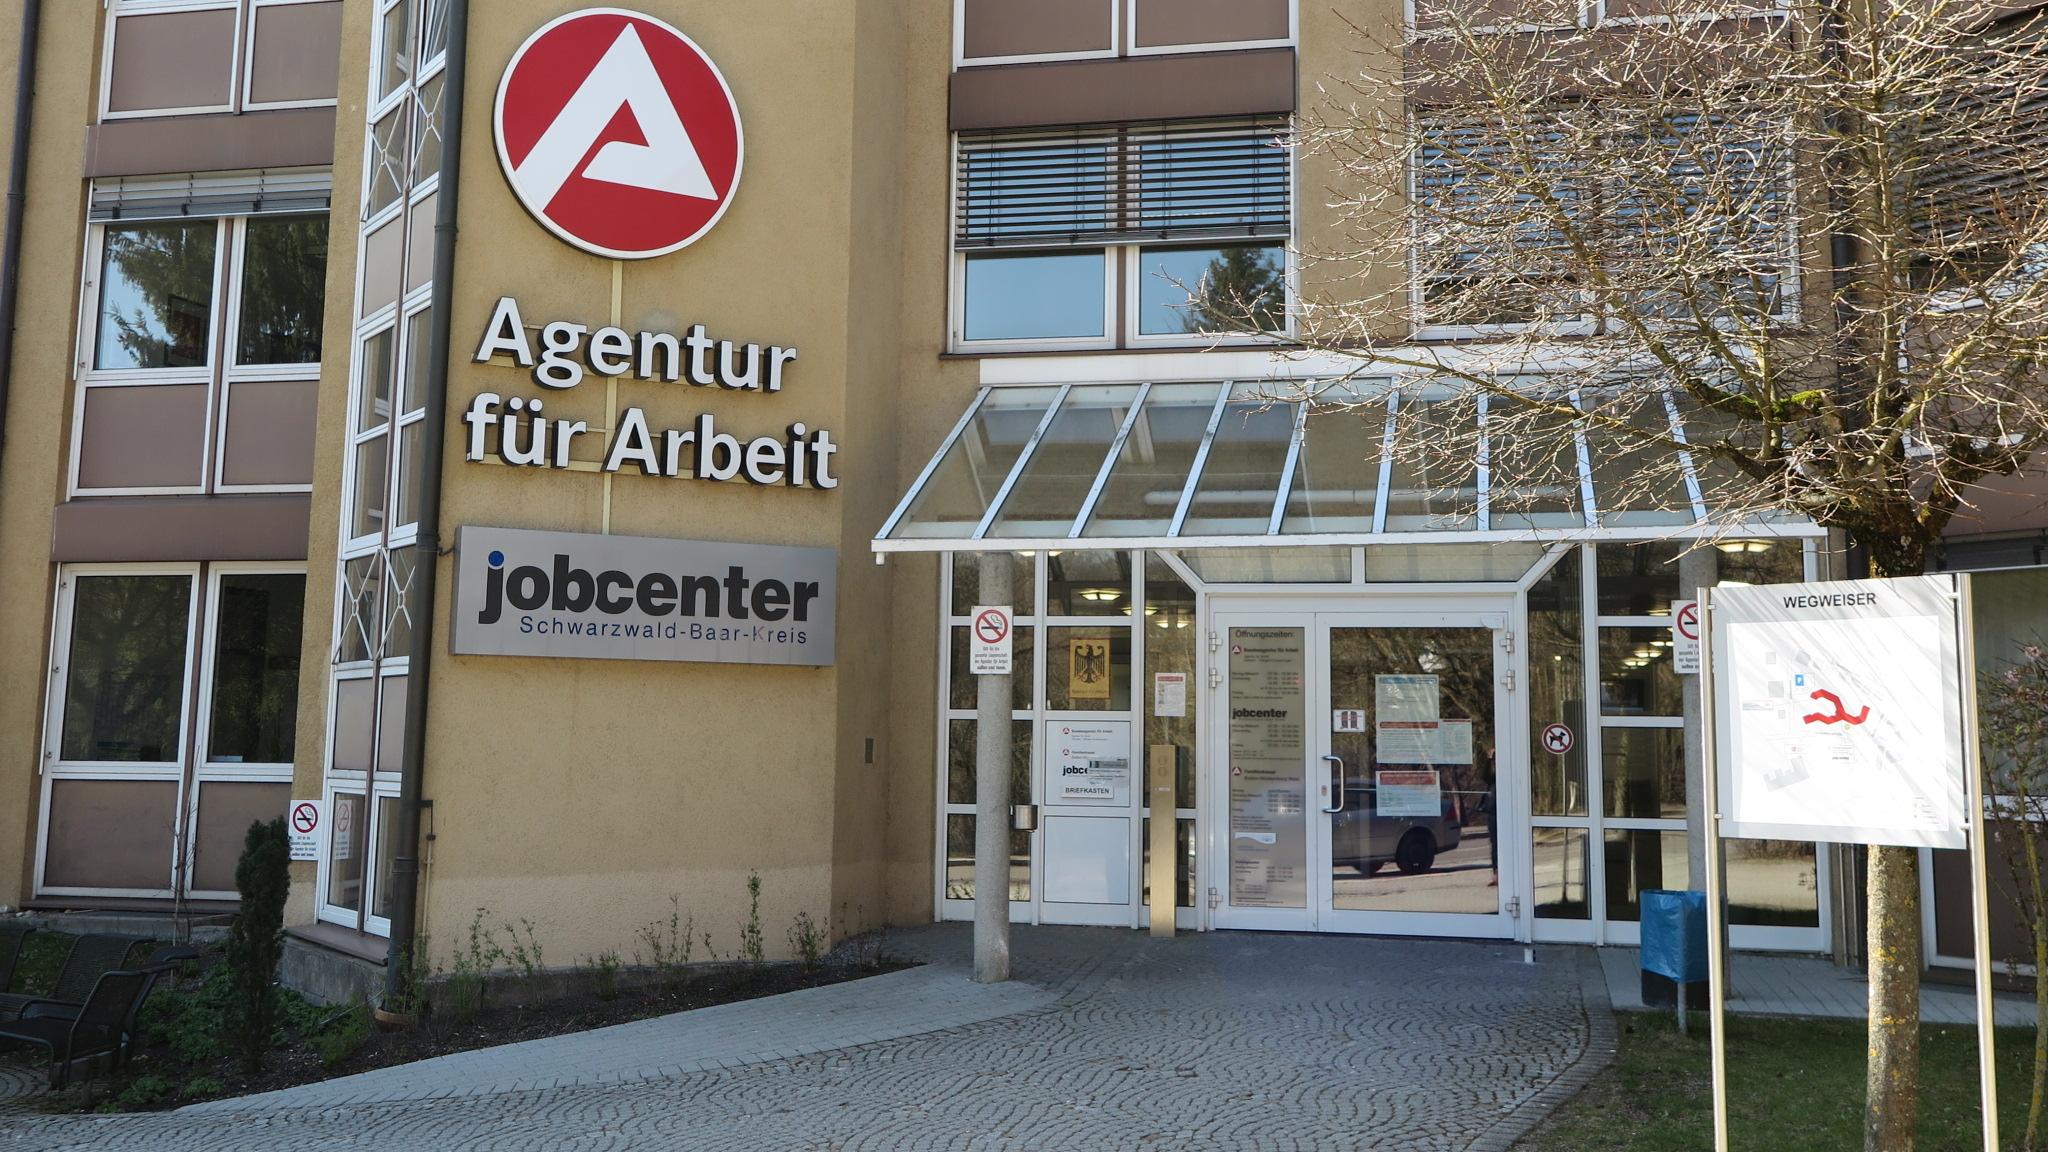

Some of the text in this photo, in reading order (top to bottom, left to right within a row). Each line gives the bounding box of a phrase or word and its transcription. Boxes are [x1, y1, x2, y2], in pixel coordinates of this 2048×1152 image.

[473, 296, 797, 391] Agentur
[465, 392, 838, 490] für Arbeit
[478, 550, 819, 625] jobcenter
[1783, 592, 1876, 609] WEGWEISER
[520, 615, 807, 645] Schwarzwald-Baar-Kreis
[1232, 708, 1288, 720] jobcenter
